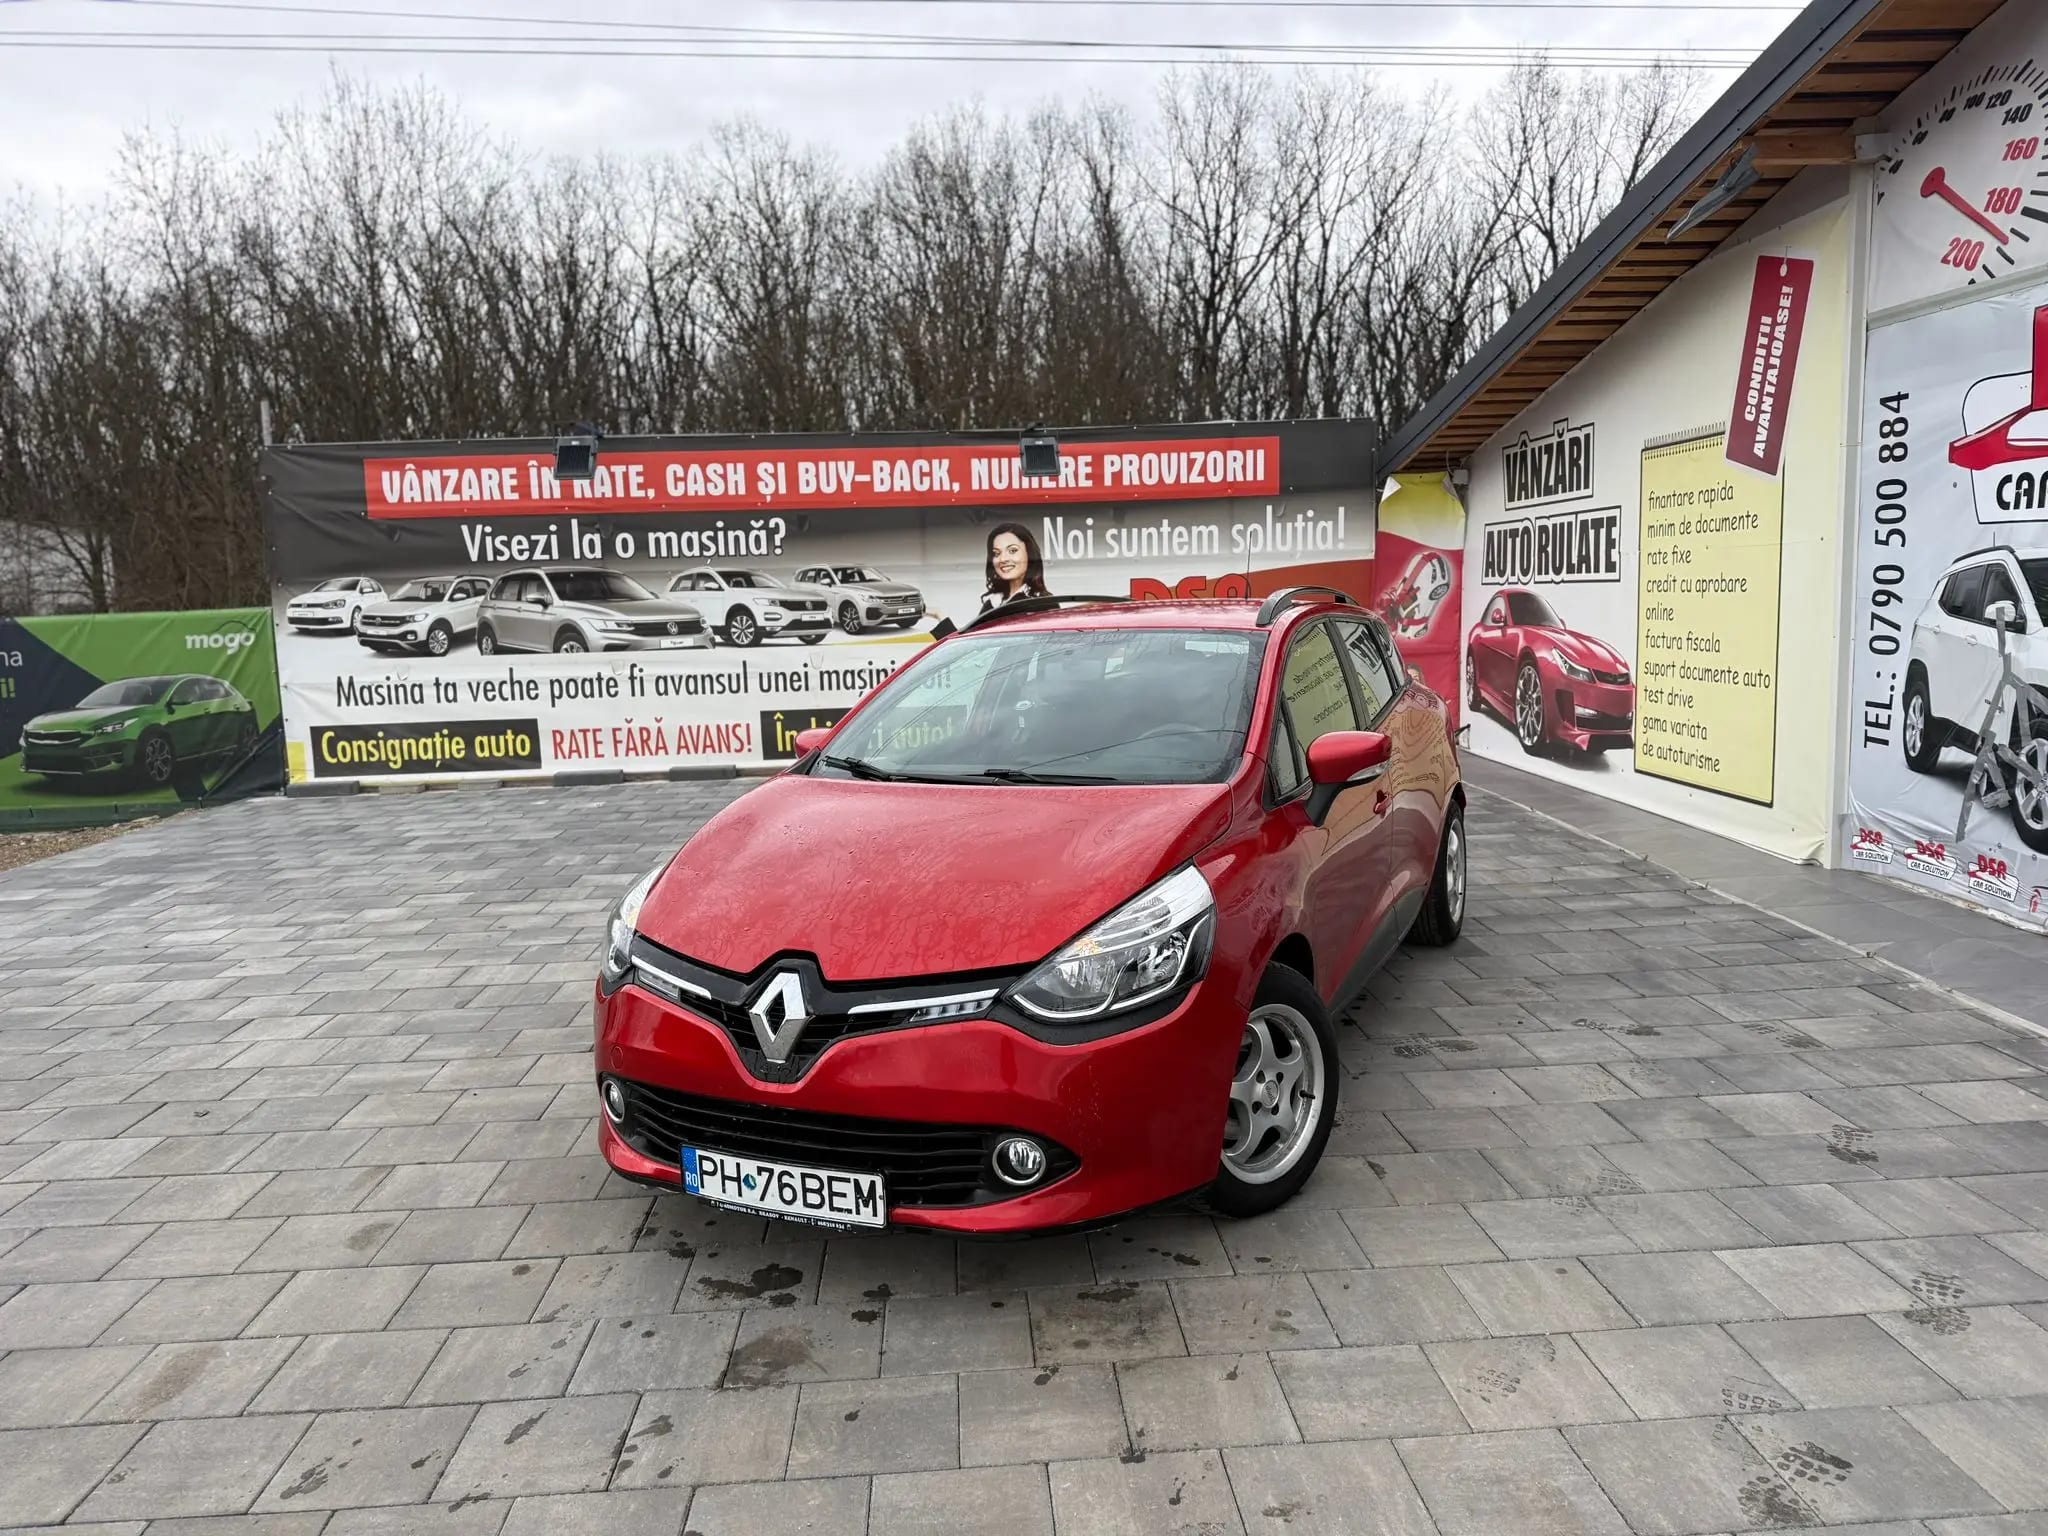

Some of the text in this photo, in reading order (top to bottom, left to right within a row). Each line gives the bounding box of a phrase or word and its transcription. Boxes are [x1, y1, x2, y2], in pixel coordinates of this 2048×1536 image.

[1985, 88, 2014, 110] 120
[2001, 102, 2034, 126] 140
[2002, 136, 2040, 162] 160
[1983, 186, 2023, 215] 180
[1940, 236, 1985, 272] 200
[1744, 315, 1773, 422] CONDITII
[1753, 285, 1794, 459] AVANTAJOASE!
[1878, 391, 1910, 464] 884
[381, 463, 519, 503] VÂNZARE
[527, 460, 561, 499] ÎN
[665, 463, 746, 497] CASH
[756, 461, 787, 503] ȘI
[1103, 449, 1265, 486] PROVIZORII
[1505, 428, 1591, 503] VÂNZĂRI
[1648, 480, 1734, 511] finantare rapida
[1647, 510, 1759, 539] minim de documente
[1874, 478, 1908, 548] 500
[460, 517, 787, 564] Visezi la o mașină?
[1043, 505, 1345, 560] Noi suntem soluția!
[1484, 515, 1617, 578] AUTO RULATE
[1647, 544, 1692, 565] rate fixe
[1646, 572, 1748, 599] credit cu aprobare
[1645, 601, 1674, 621] online
[1868, 564, 1905, 656] 0790
[185, 630, 256, 655] mogo
[1645, 628, 1721, 653] factura fiscala
[433, 676, 458, 704] ta
[467, 667, 539, 703] veche
[549, 672, 620, 708] poate
[628, 663, 645, 697] fi
[654, 660, 749, 696] avansul
[758, 662, 809, 693] unei
[819, 660, 896, 697] mașin
[1643, 660, 1771, 689] suport documente auto
[1643, 685, 1694, 709] test drive
[551, 728, 605, 760] RATE
[611, 717, 669, 758] FĂRĂ
[676, 722, 753, 756] AVANS!
[1642, 715, 1708, 741] gama variata
[321, 728, 532, 769] Consignație auto
[1641, 737, 1721, 773] de autoturisme
[1922, 863, 1950, 878] SOLUTION
[1984, 882, 2012, 899] SOLUTION
[685, 1171, 697, 1187] RO
